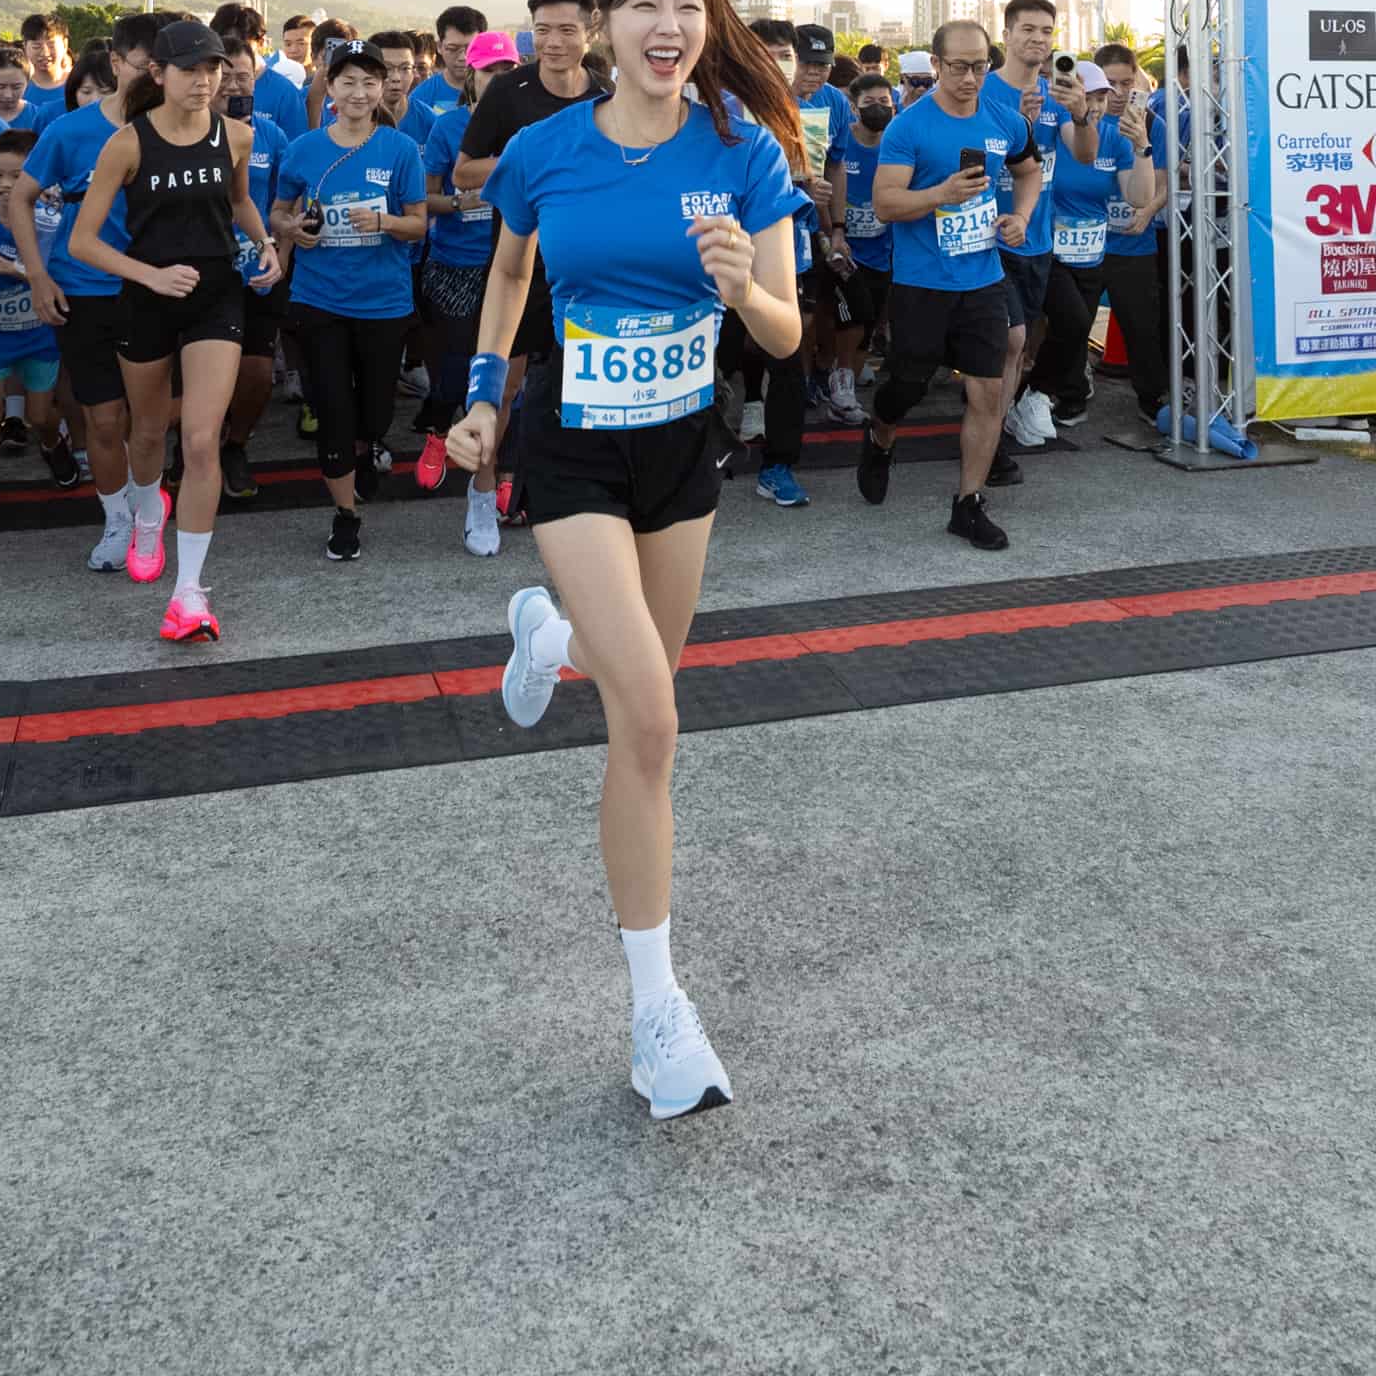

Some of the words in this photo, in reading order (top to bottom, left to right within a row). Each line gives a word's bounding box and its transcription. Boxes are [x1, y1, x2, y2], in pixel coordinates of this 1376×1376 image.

[1277, 133, 1352, 151] Carrefour
[1285, 153, 1353, 172] 家樂福
[151, 167, 222, 192] PACER
[681, 192, 733, 206] POCARI
[681, 202, 729, 216] SWEAT
[1322, 257, 1376, 277] 燒肉屋
[575, 334, 706, 383] 16888
[632, 388, 657, 401] 小安
